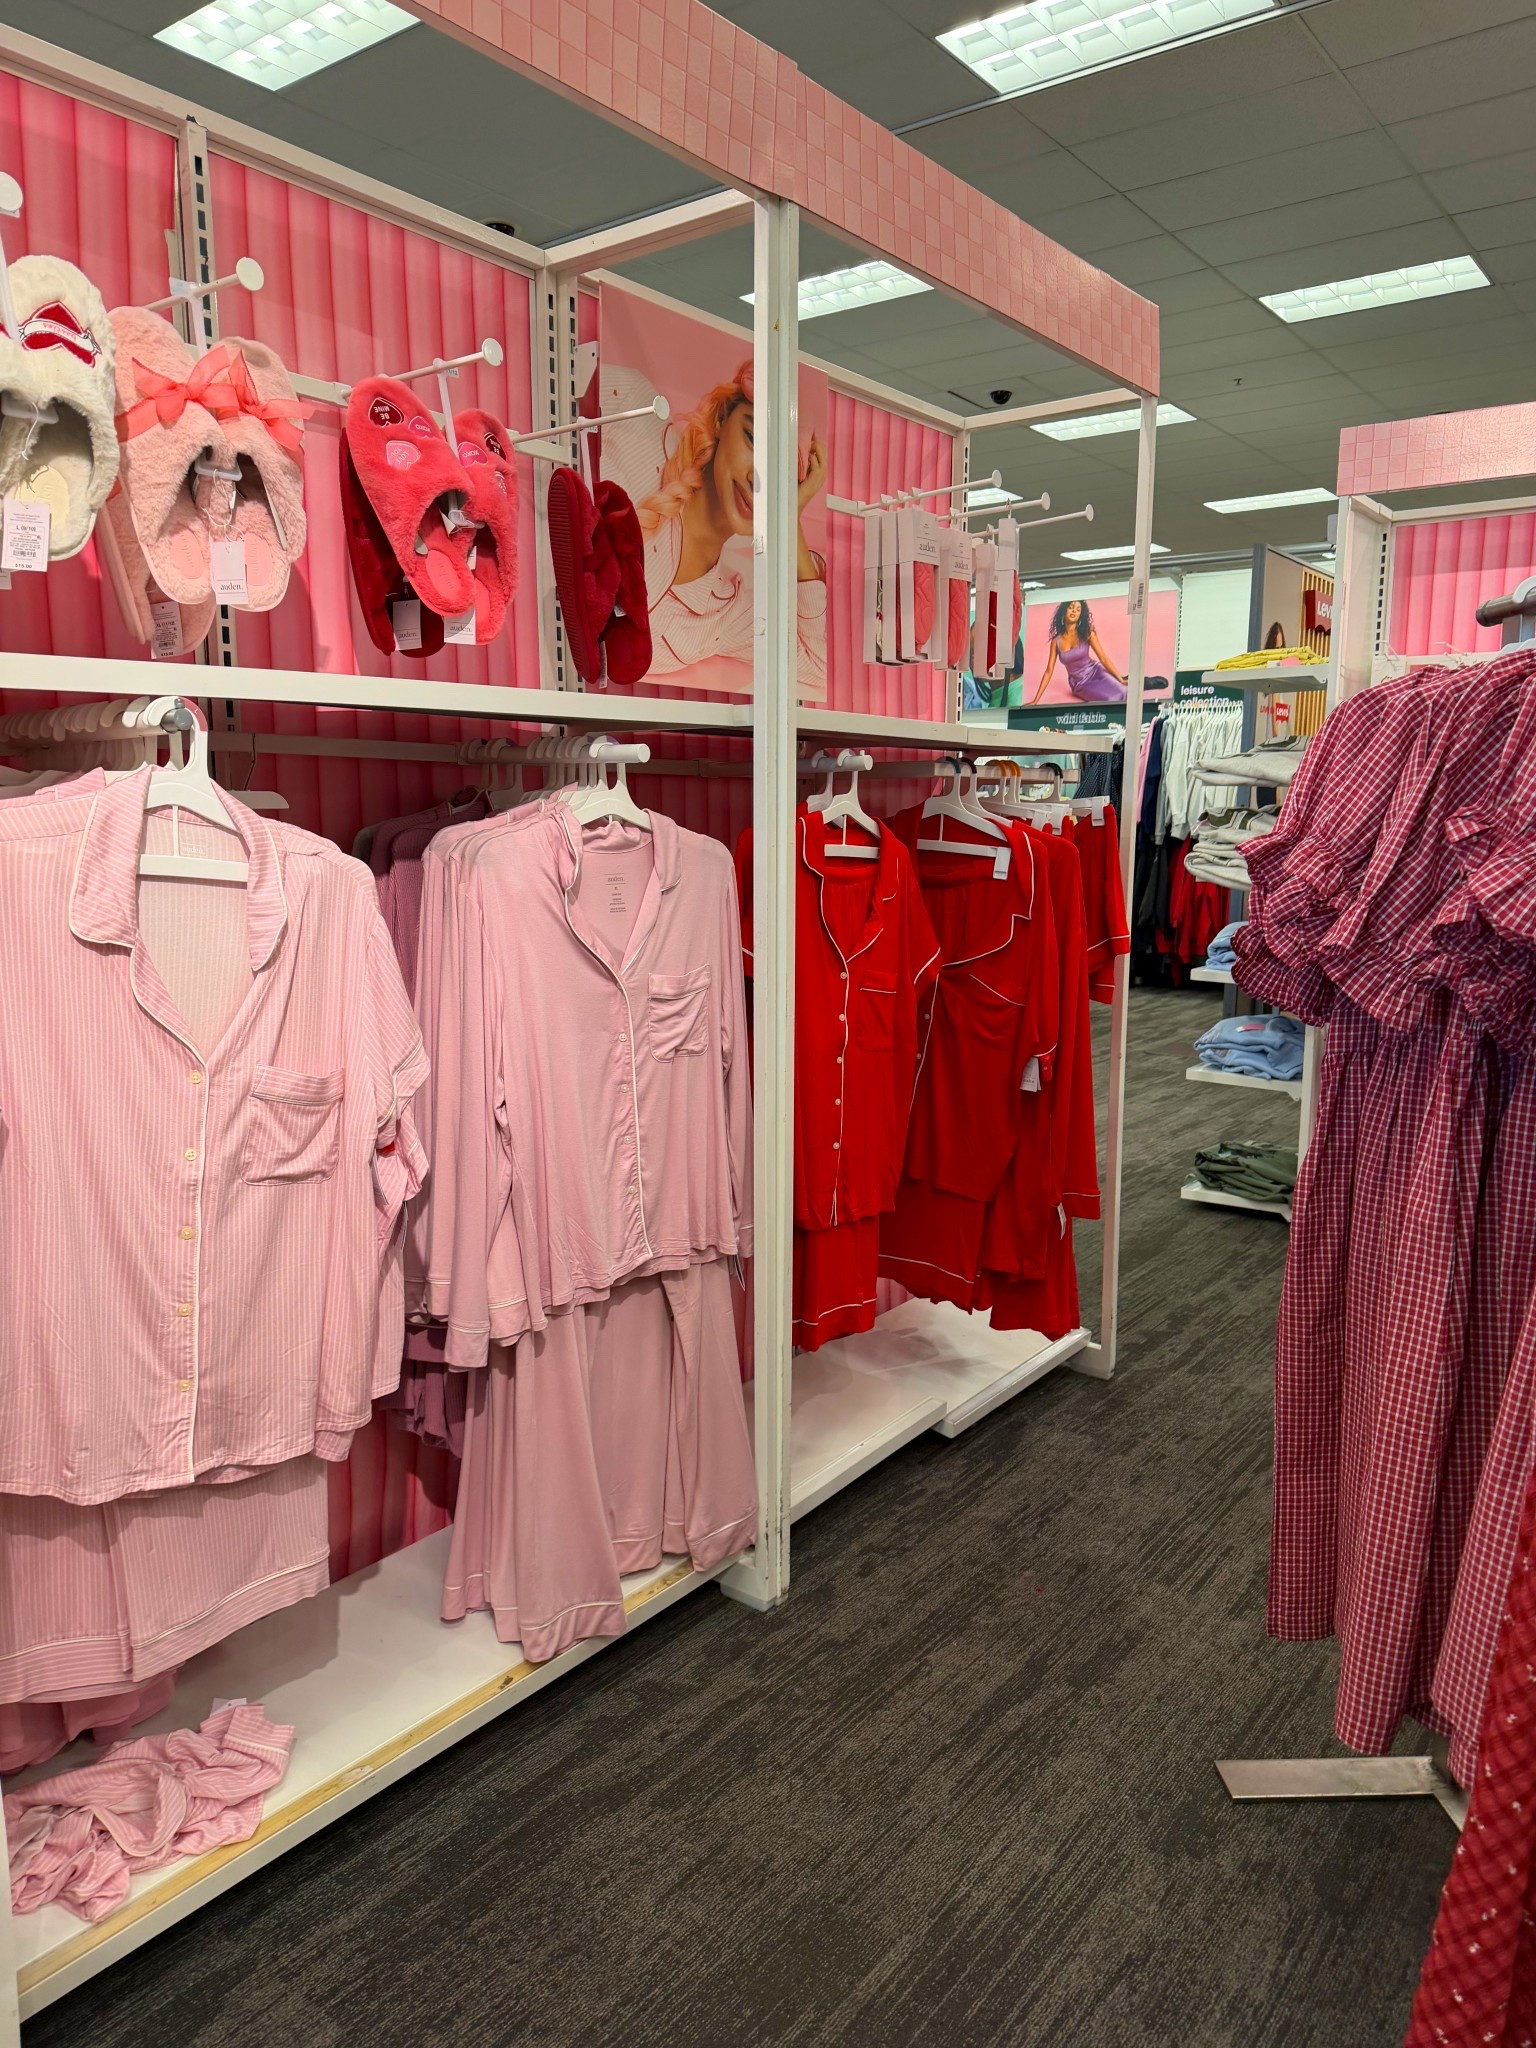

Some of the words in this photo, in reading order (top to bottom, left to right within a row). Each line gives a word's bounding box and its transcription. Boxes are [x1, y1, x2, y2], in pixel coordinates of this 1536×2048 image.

[463, 449, 479, 458] XOXO
[1180, 684, 1215, 696] leisure
[1180, 696, 1230, 708] collection
[1056, 712, 1078, 725] wild
[1079, 711, 1107, 724] fable
